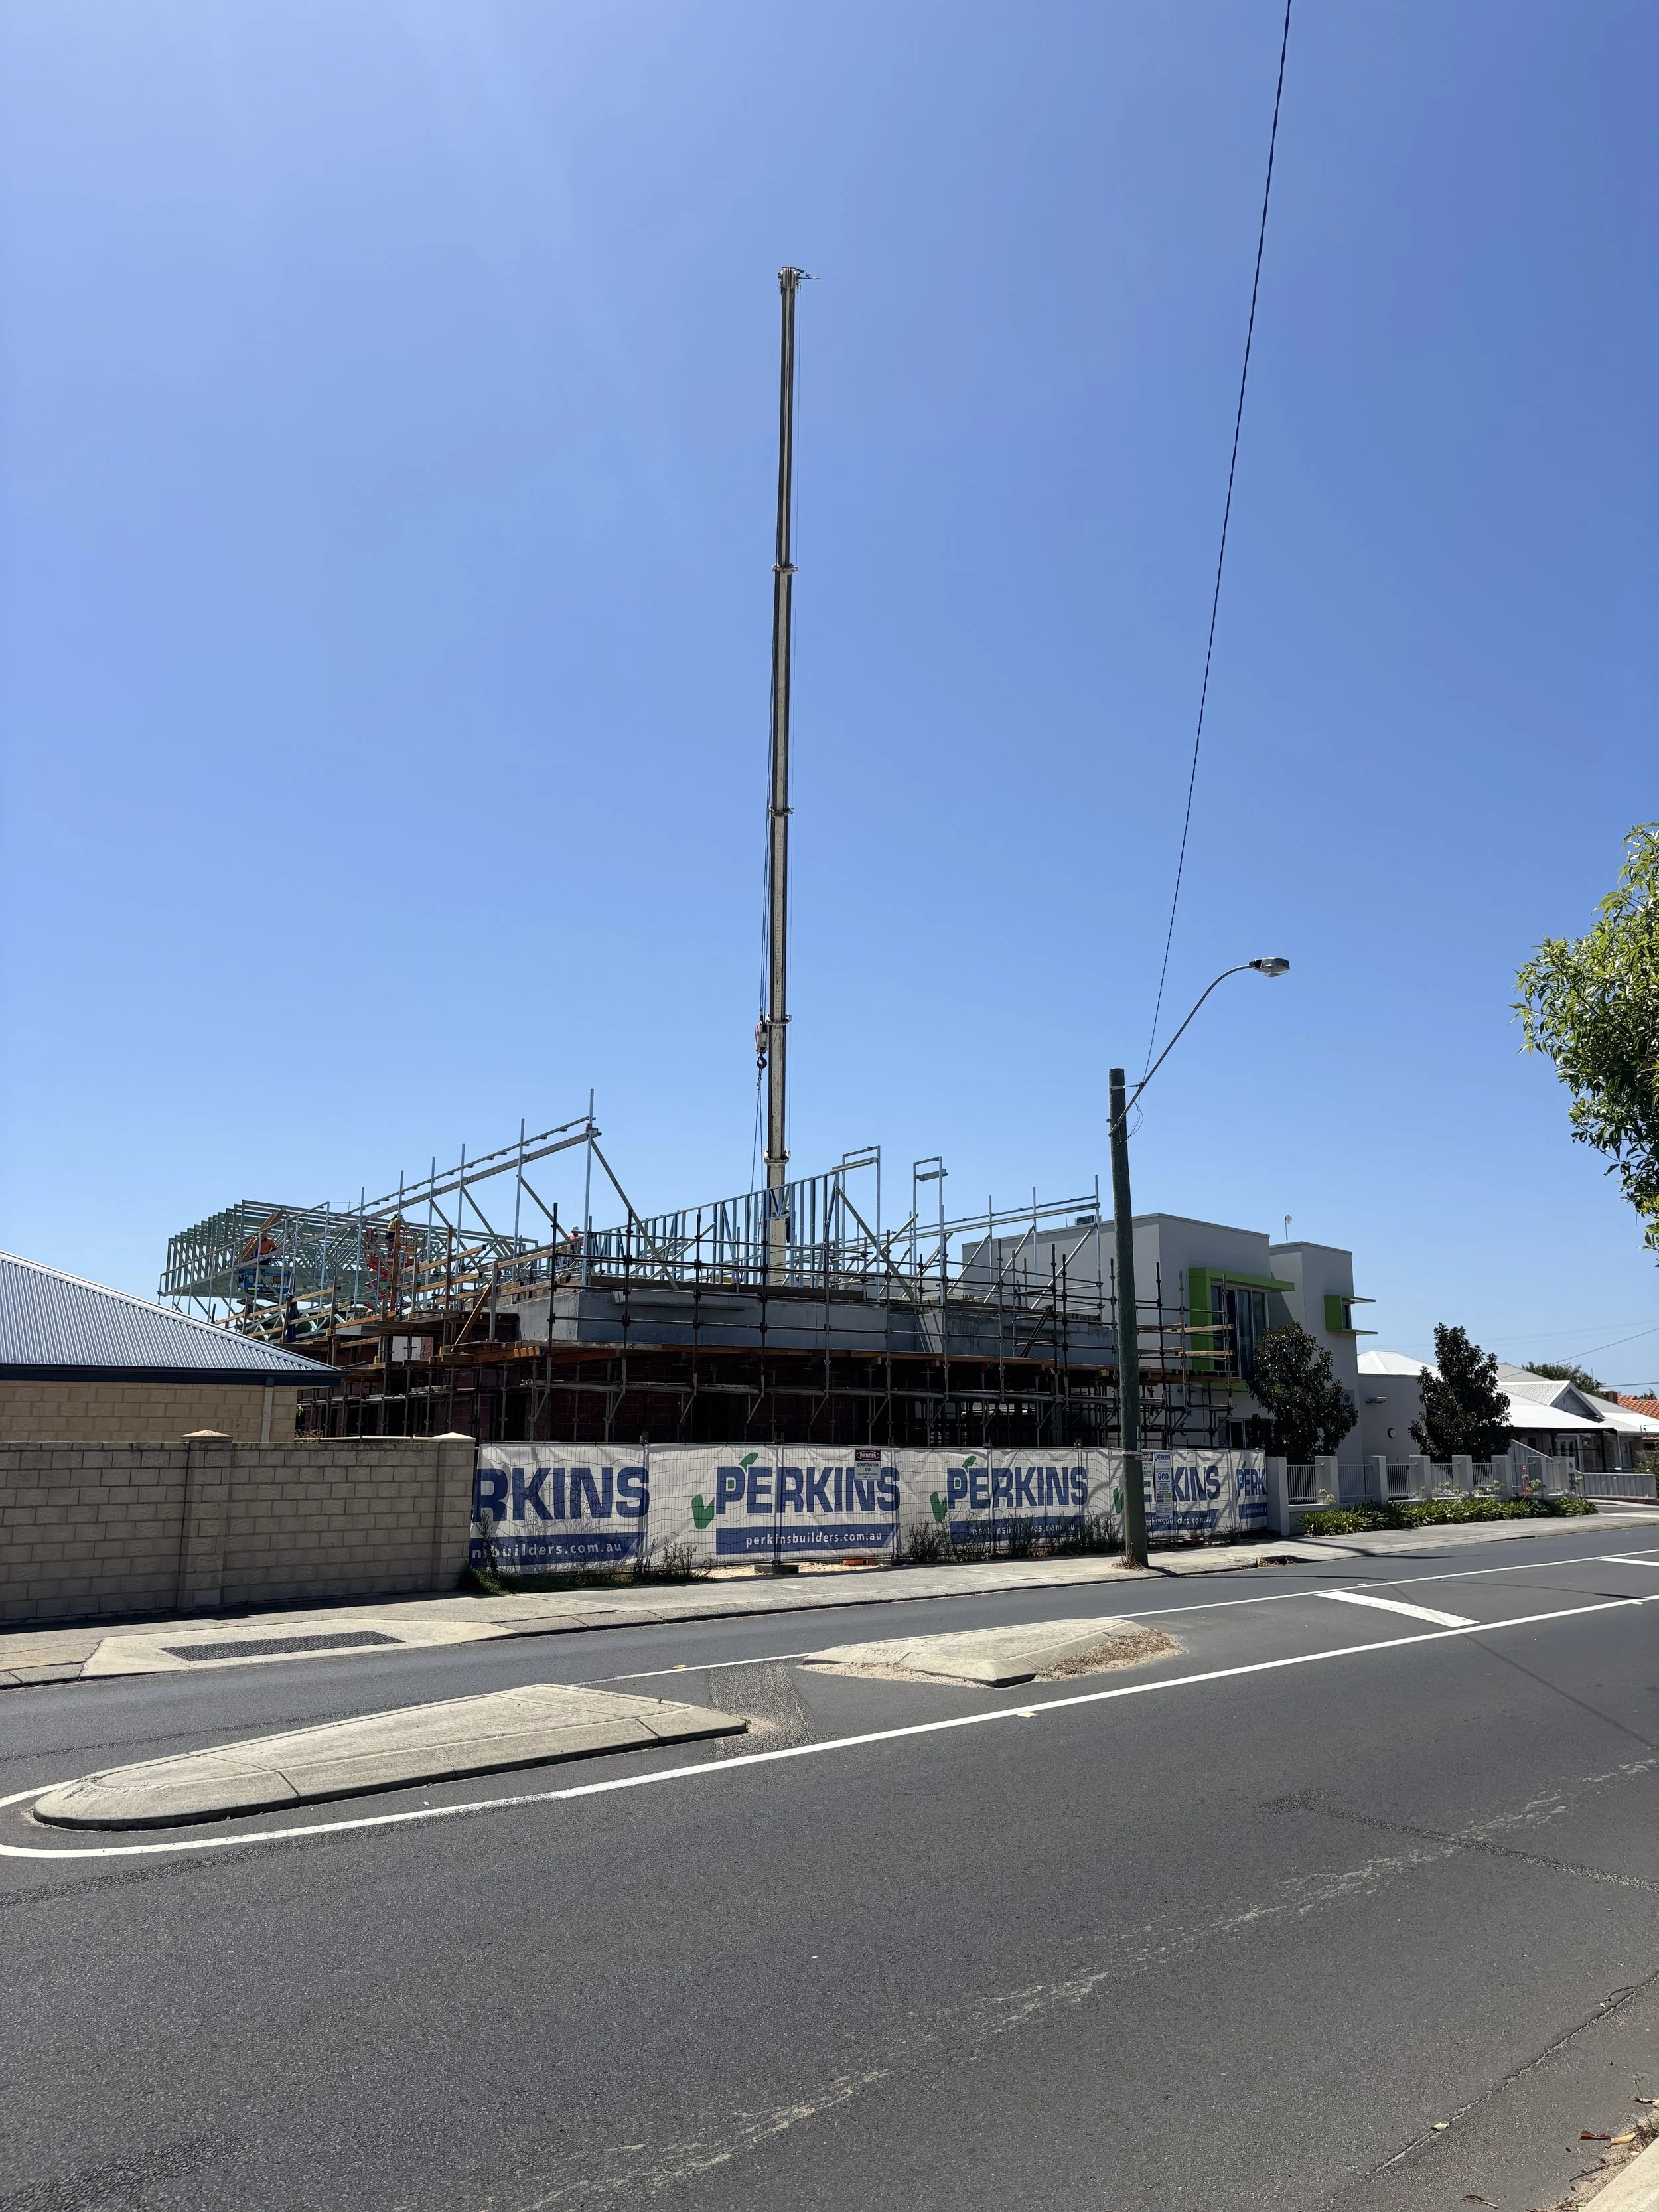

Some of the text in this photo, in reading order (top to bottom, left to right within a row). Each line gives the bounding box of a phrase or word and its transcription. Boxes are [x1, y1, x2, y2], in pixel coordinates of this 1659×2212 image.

[472, 1467, 650, 1522] RKINS
[716, 1466, 901, 1514] PERKINS
[947, 1466, 1088, 1509] PERKINS
[746, 1532, 882, 1548] perkinsbuilders.com.au
